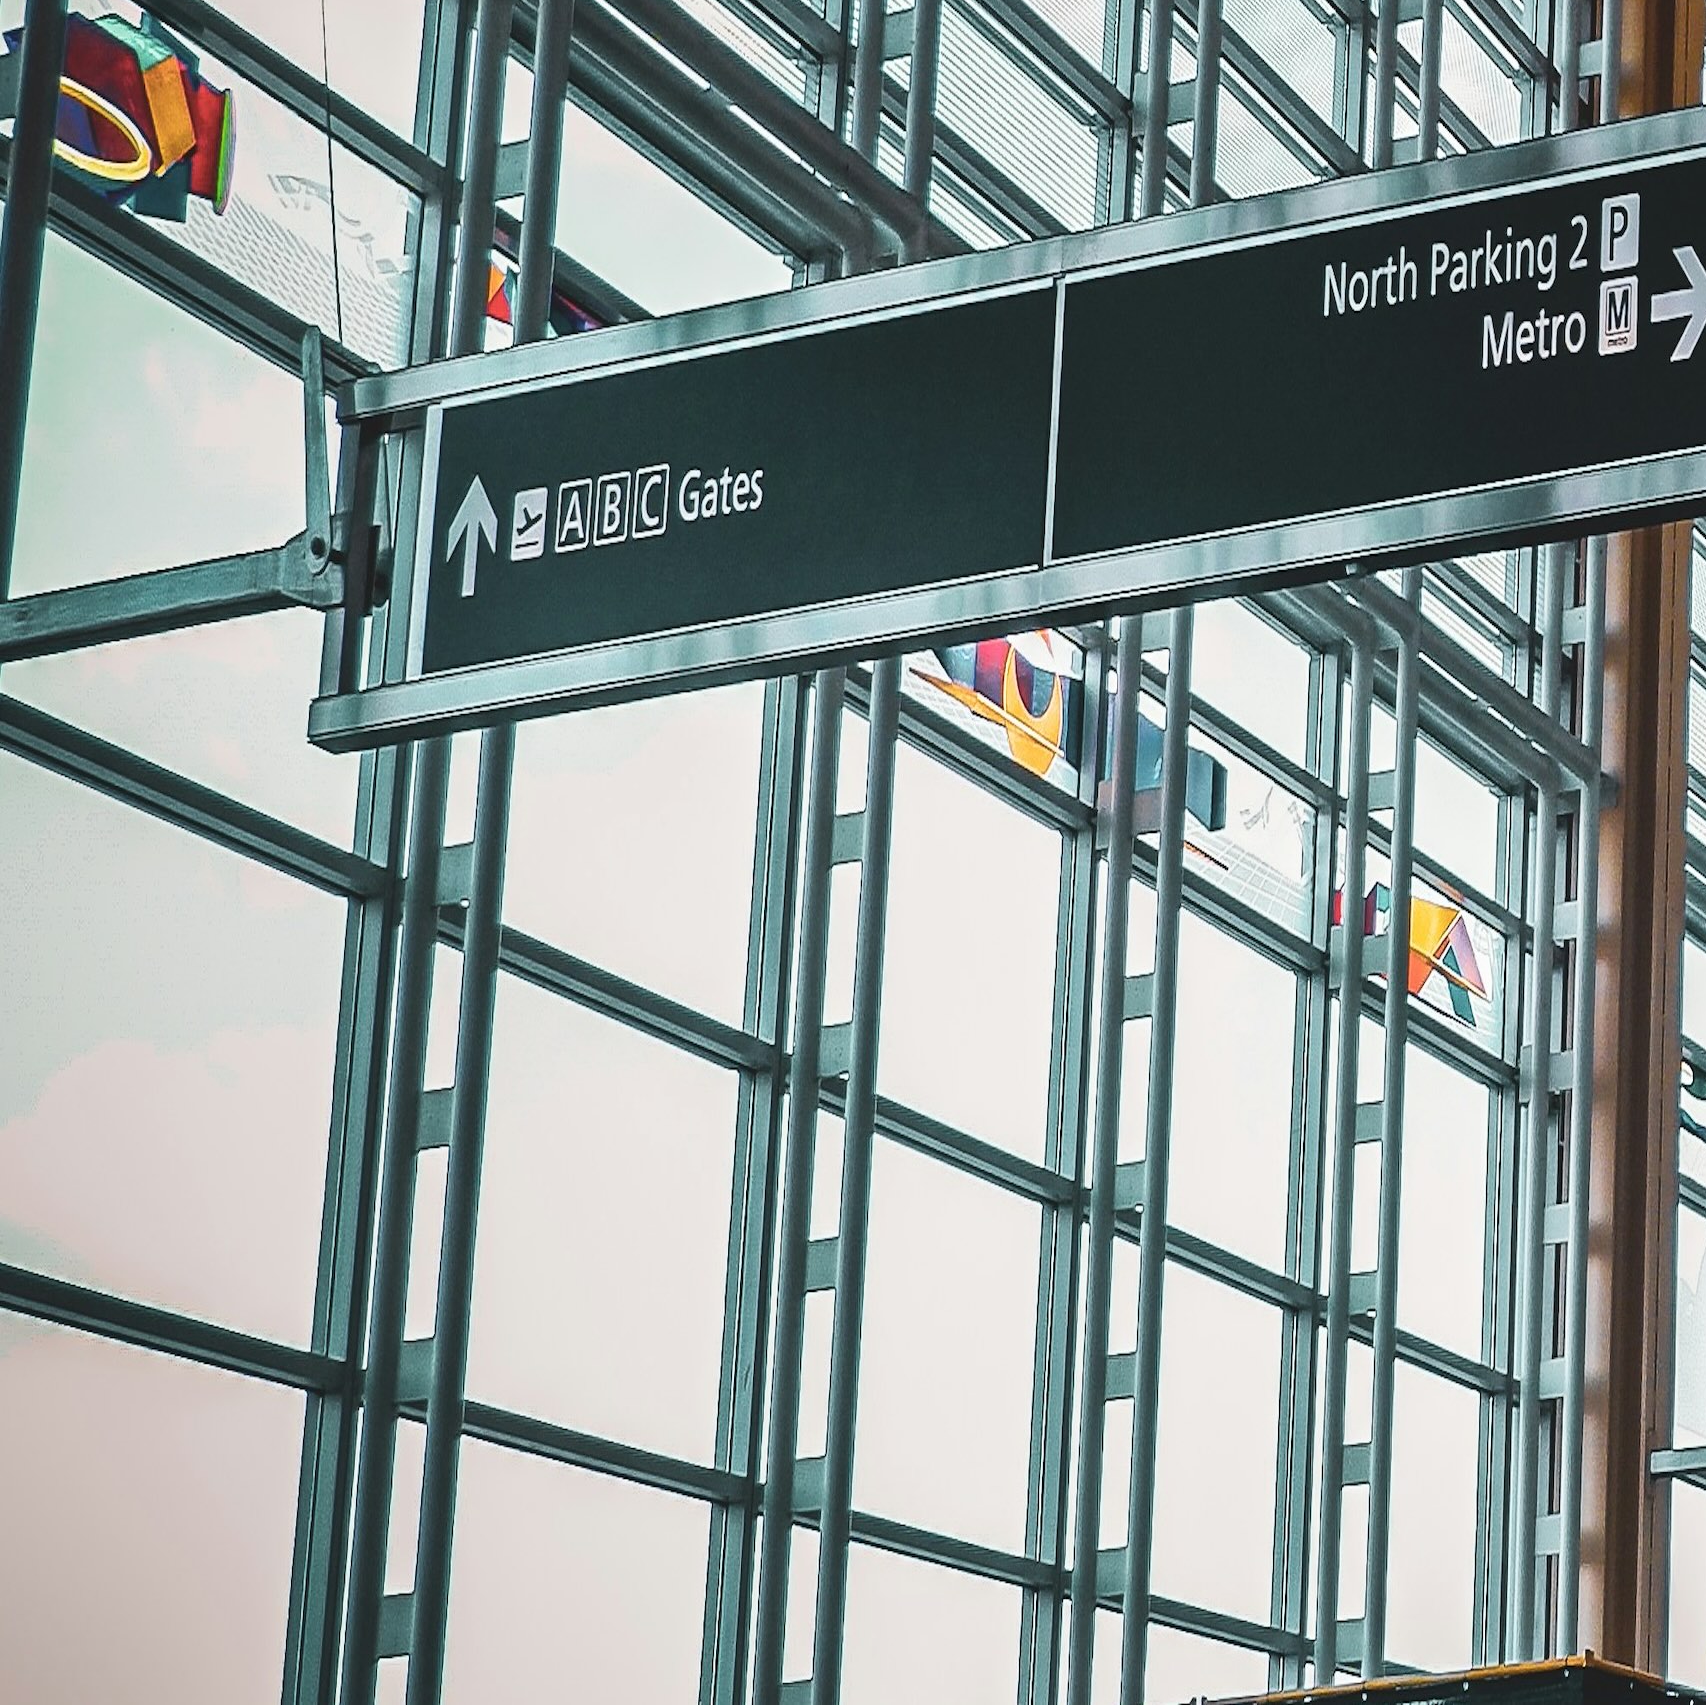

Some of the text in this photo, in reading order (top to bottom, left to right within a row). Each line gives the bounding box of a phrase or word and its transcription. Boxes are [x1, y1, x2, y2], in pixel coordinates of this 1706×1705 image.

[1323, 206, 1628, 317] North Parking 2 P
[1481, 289, 1629, 370] Metro M
[561, 466, 764, 542] A B C Gates
